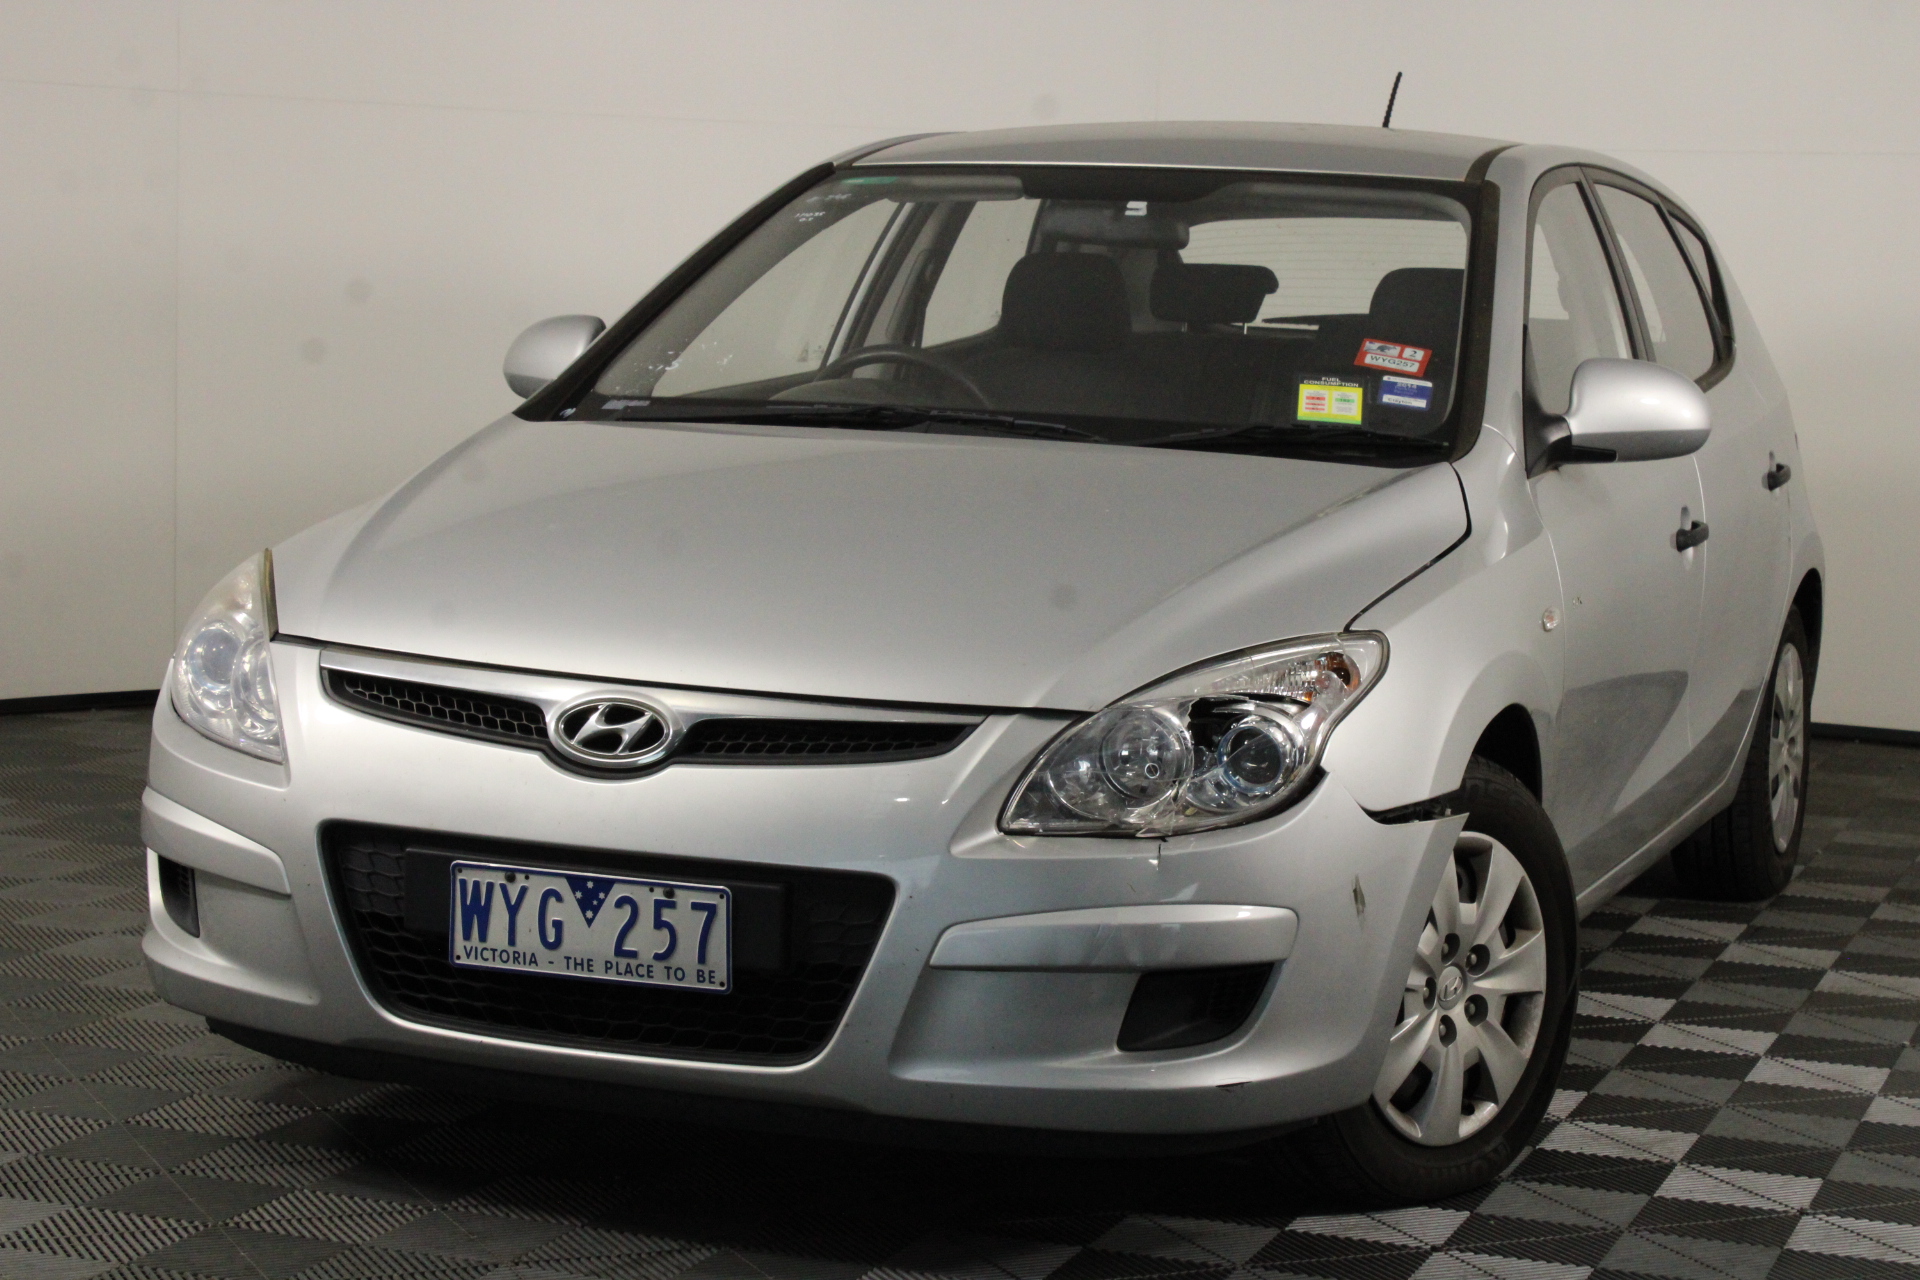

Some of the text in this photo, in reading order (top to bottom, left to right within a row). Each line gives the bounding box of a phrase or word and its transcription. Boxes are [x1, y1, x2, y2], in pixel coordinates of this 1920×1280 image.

[1409, 350, 1418, 358] 2
[1370, 355, 1415, 368] WYG257
[1303, 380, 1359, 388] CONSUMPTION
[458, 877, 718, 965] WYG 257
[463, 944, 539, 967] VICTORIA
[563, 955, 595, 973] THE
[604, 960, 655, 979] PLACE
[664, 965, 686, 982] TO
[696, 969, 717, 985] BE
